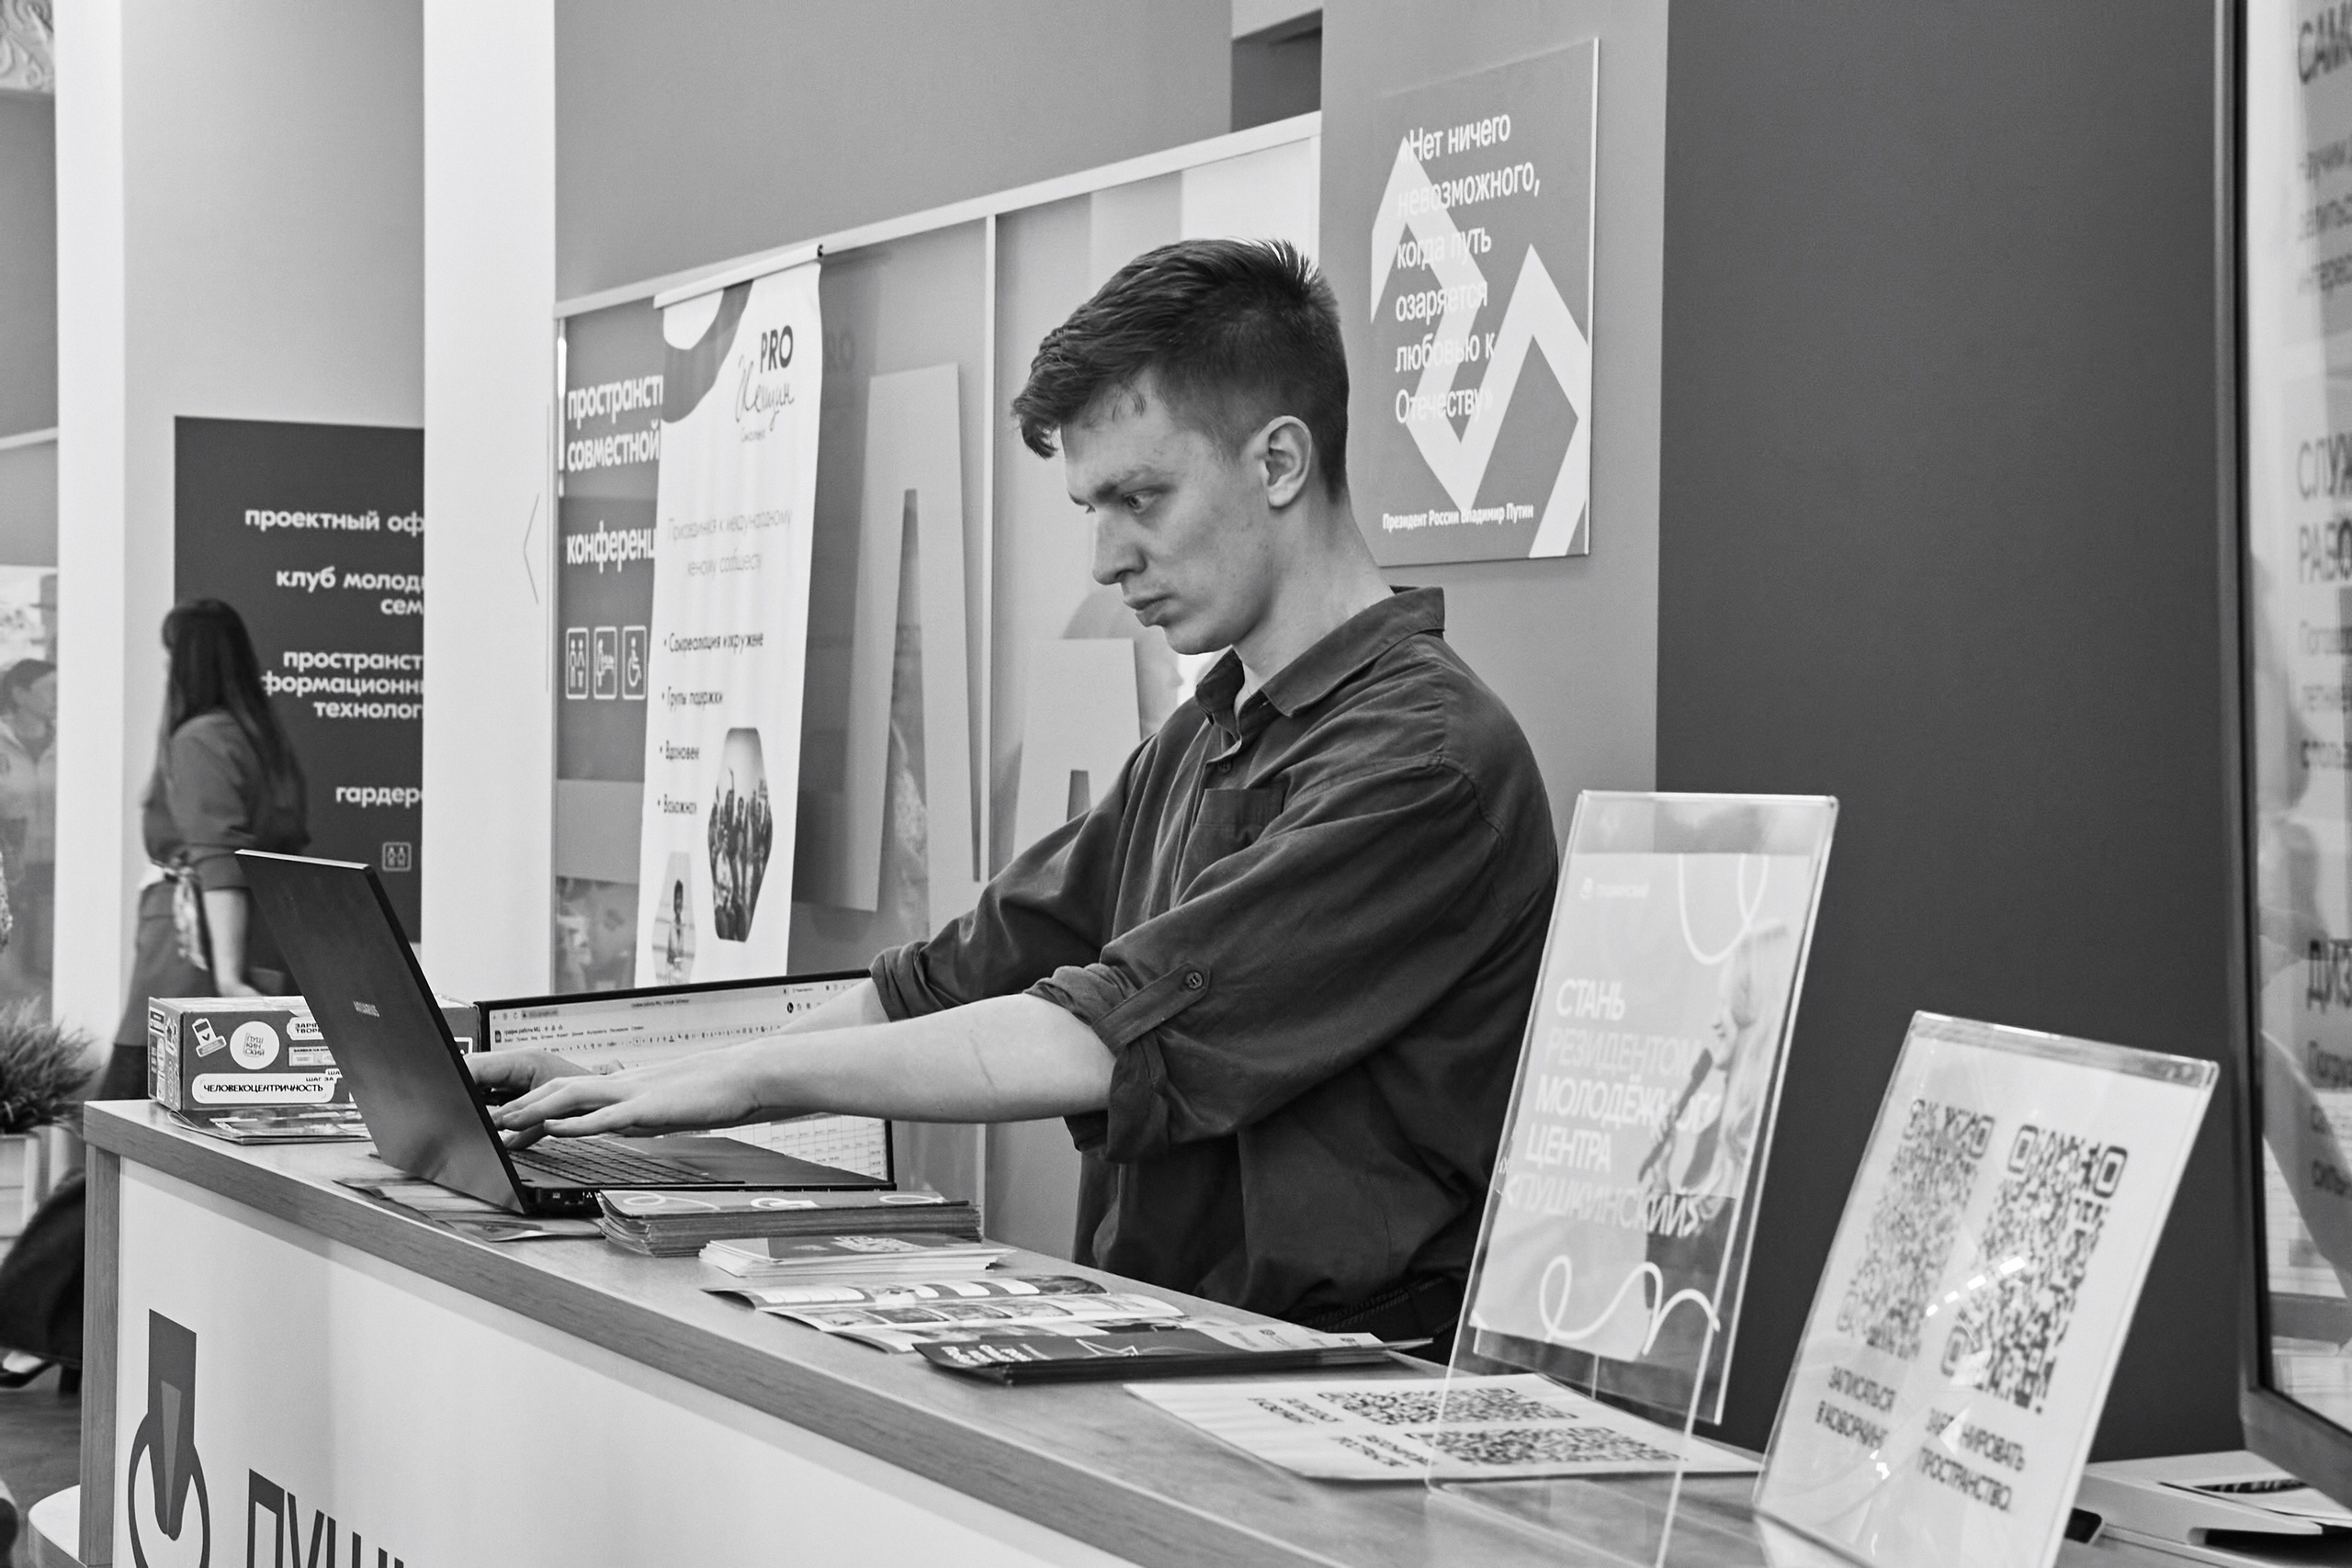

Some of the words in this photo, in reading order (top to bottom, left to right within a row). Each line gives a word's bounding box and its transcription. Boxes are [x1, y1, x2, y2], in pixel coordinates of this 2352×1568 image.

[1448, 114, 1510, 154] ничего
[1398, 162, 1541, 220] невозможного,
[1397, 234, 1444, 270] когда
[1450, 227, 1492, 265] путь
[1396, 280, 1487, 324] озаряется
[760, 324, 794, 374] PRO
[1395, 333, 1480, 373] любовью
[1485, 332, 1496, 359] к
[568, 419, 660, 472] совместной
[245, 509, 380, 532] проектный
[1383, 512, 1427, 533] Президент
[1429, 509, 1460, 527] России
[1461, 505, 1505, 525] Владимир
[1506, 502, 1534, 522] Путин
[277, 566, 336, 592] клуб
[1555, 977, 1627, 1021] СТАНЬ
[203, 1084, 323, 1093] ЧЕЛОВЕКОЦЕНТРИЧНОСТЬ
[1524, 1122, 1613, 1173] ЦЕНТРА
